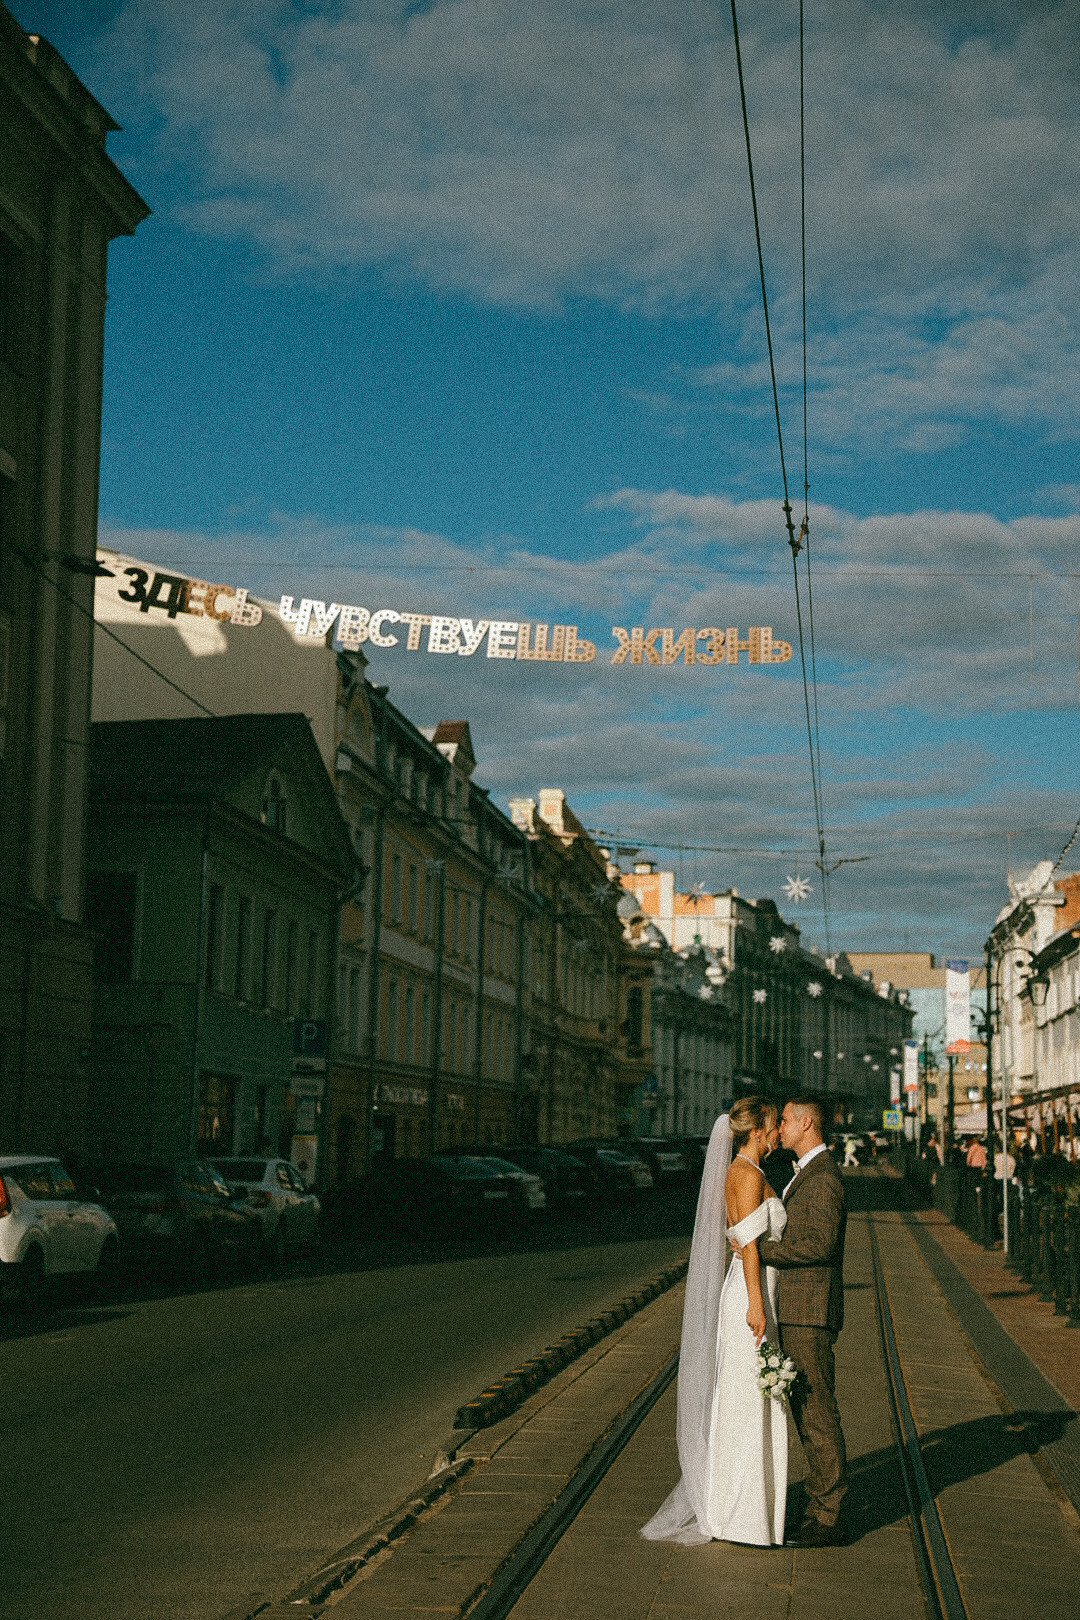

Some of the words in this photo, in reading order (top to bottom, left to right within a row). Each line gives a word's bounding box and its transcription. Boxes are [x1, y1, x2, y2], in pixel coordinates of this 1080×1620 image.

[119, 567, 262, 627] ЗДЕСЬ
[279, 595, 596, 663] ЧУВСТВУЕШЬ
[611, 626, 793, 666] ЖИЗНЬ
[301, 1023, 318, 1050] P
